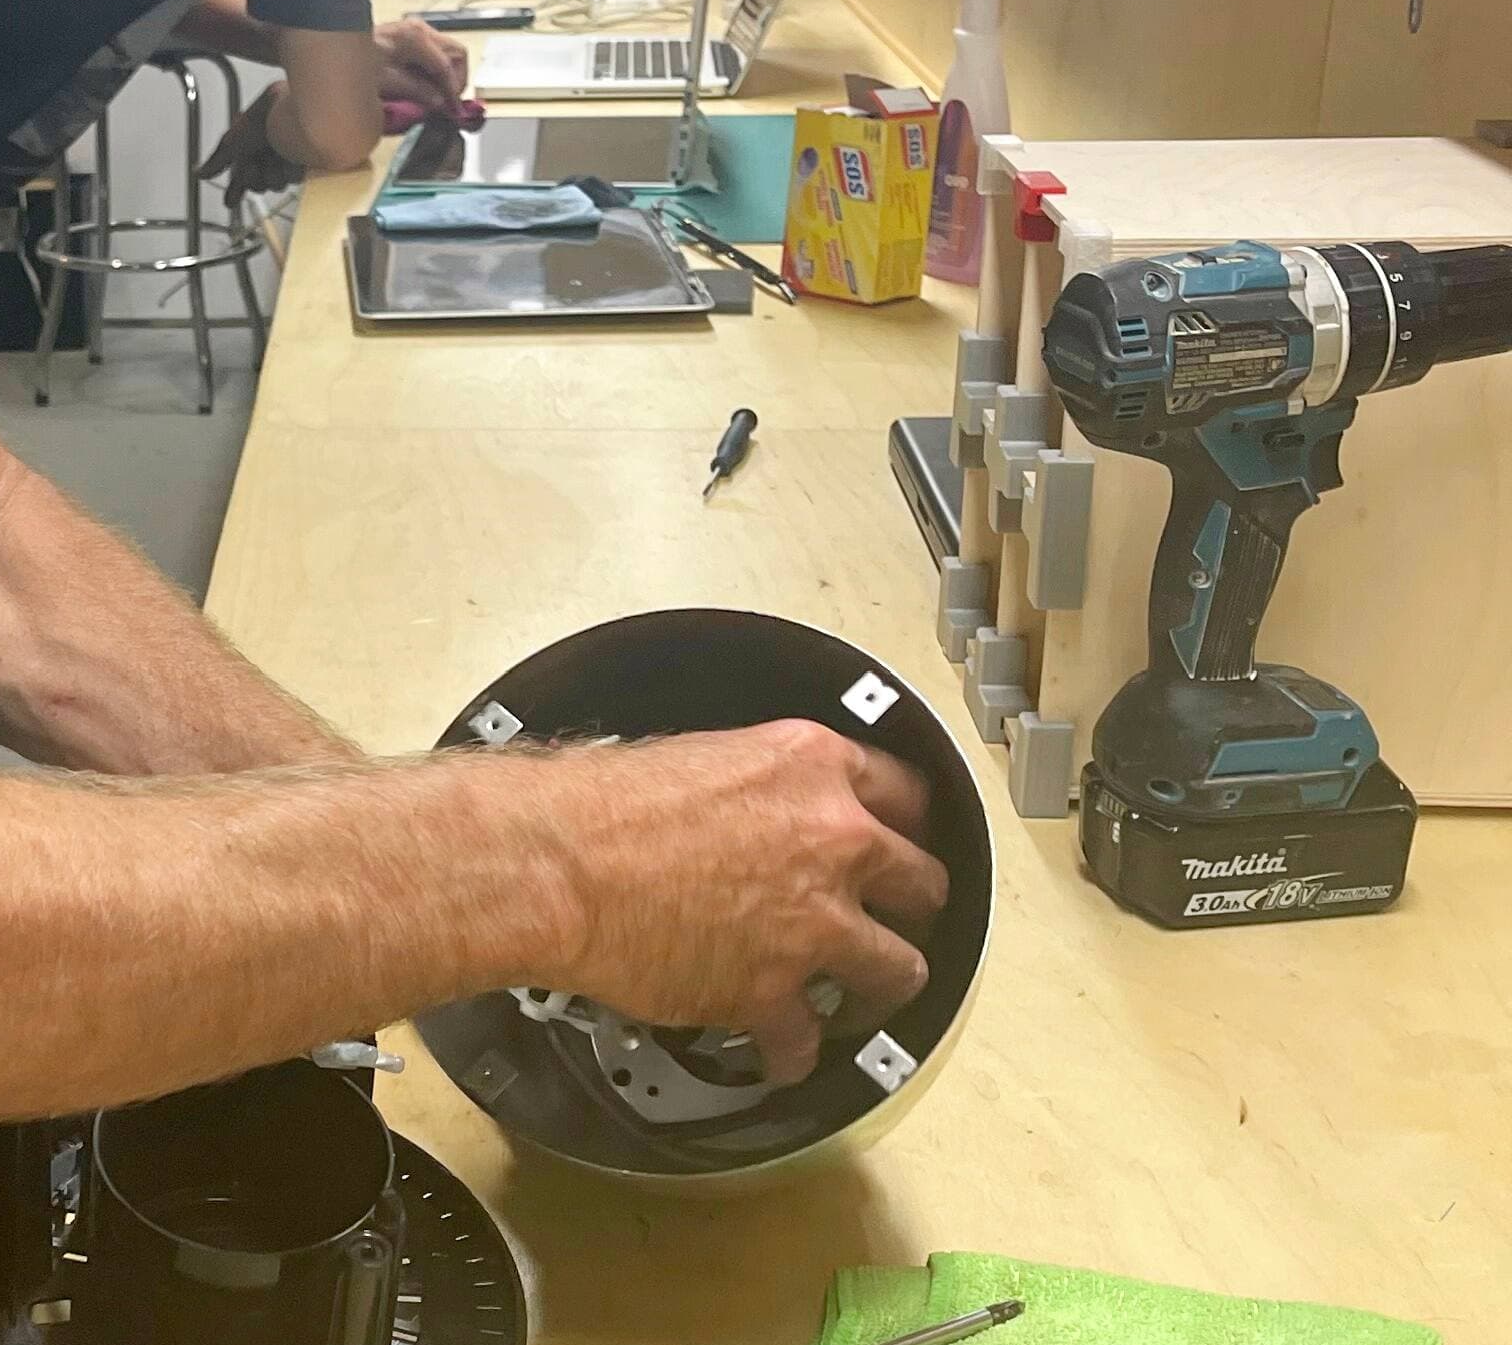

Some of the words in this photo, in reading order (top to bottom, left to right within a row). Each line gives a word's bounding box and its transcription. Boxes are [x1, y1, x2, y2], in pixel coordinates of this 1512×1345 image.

[1389, 273, 1404, 283] 5
[1398, 300, 1411, 311] 7
[1399, 331, 1412, 341] 9
